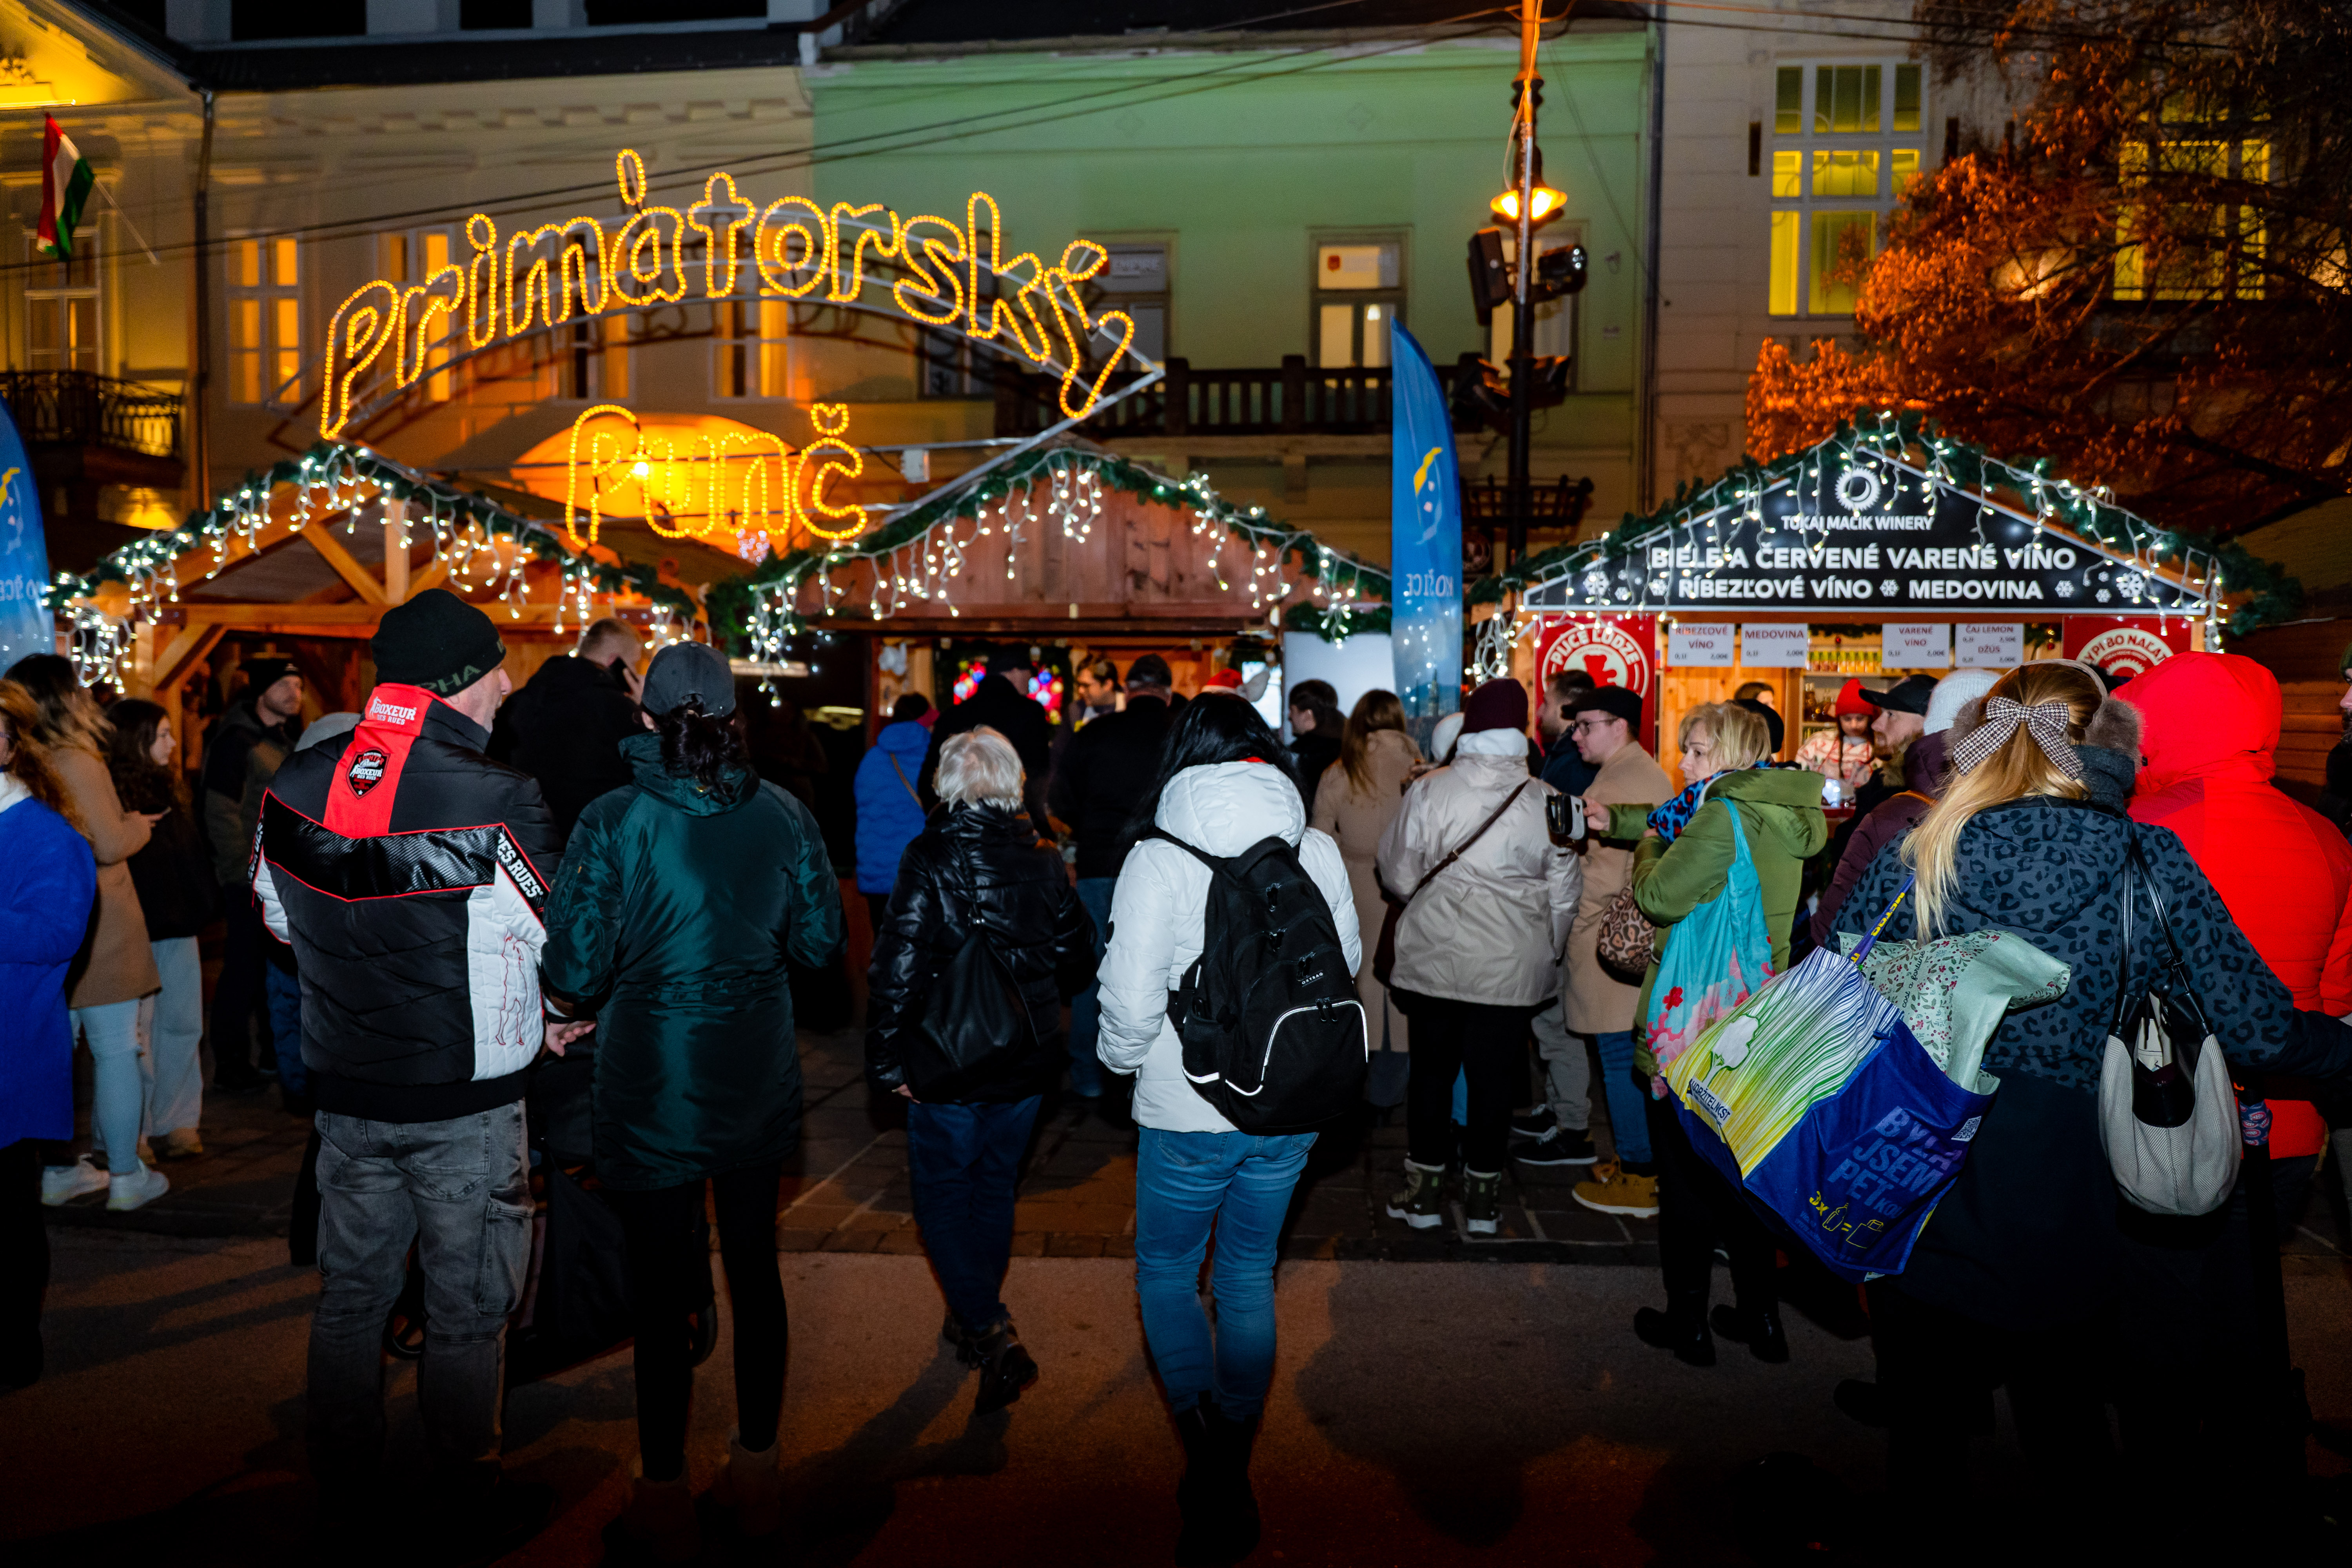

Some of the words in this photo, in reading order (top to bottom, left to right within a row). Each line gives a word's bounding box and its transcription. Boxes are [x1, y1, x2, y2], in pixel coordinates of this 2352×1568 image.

[320, 149, 1136, 439] Primátorský
[566, 403, 868, 548] Punč
[1781, 515, 1825, 531] TOKAJ
[1875, 515, 1935, 531] WINERY
[1651, 547, 1723, 569] BIELE
[1728, 547, 1749, 569] A
[1755, 542, 1880, 570] ČERVENÉ
[1887, 543, 1997, 570] VARENÉ
[2004, 543, 2076, 570] VÍNO
[1679, 575, 1805, 599] RÍBEZĽOVÉ
[1810, 575, 1873, 599] VÍNO
[1909, 580, 2044, 600] MEDOVINA
[1744, 630, 1804, 639] MEDOVINA
[1898, 624, 1933, 635] VARENÉ
[1965, 623, 1980, 633] ČAJ
[1592, 628, 1641, 665] ĽUDZE
[1688, 639, 1714, 649] VÍNO
[1904, 638, 1927, 646] VÍNO
[2106, 635, 2124, 648] BO
[374, 702, 416, 721] BOXEUR
[387, 715, 405, 725] RUES
[507, 858, 541, 898] RUES
[1911, 950, 1925, 981] fortune
[1301, 972, 1323, 985] OXYBAG
[1853, 1137, 1944, 1196] JSEM
